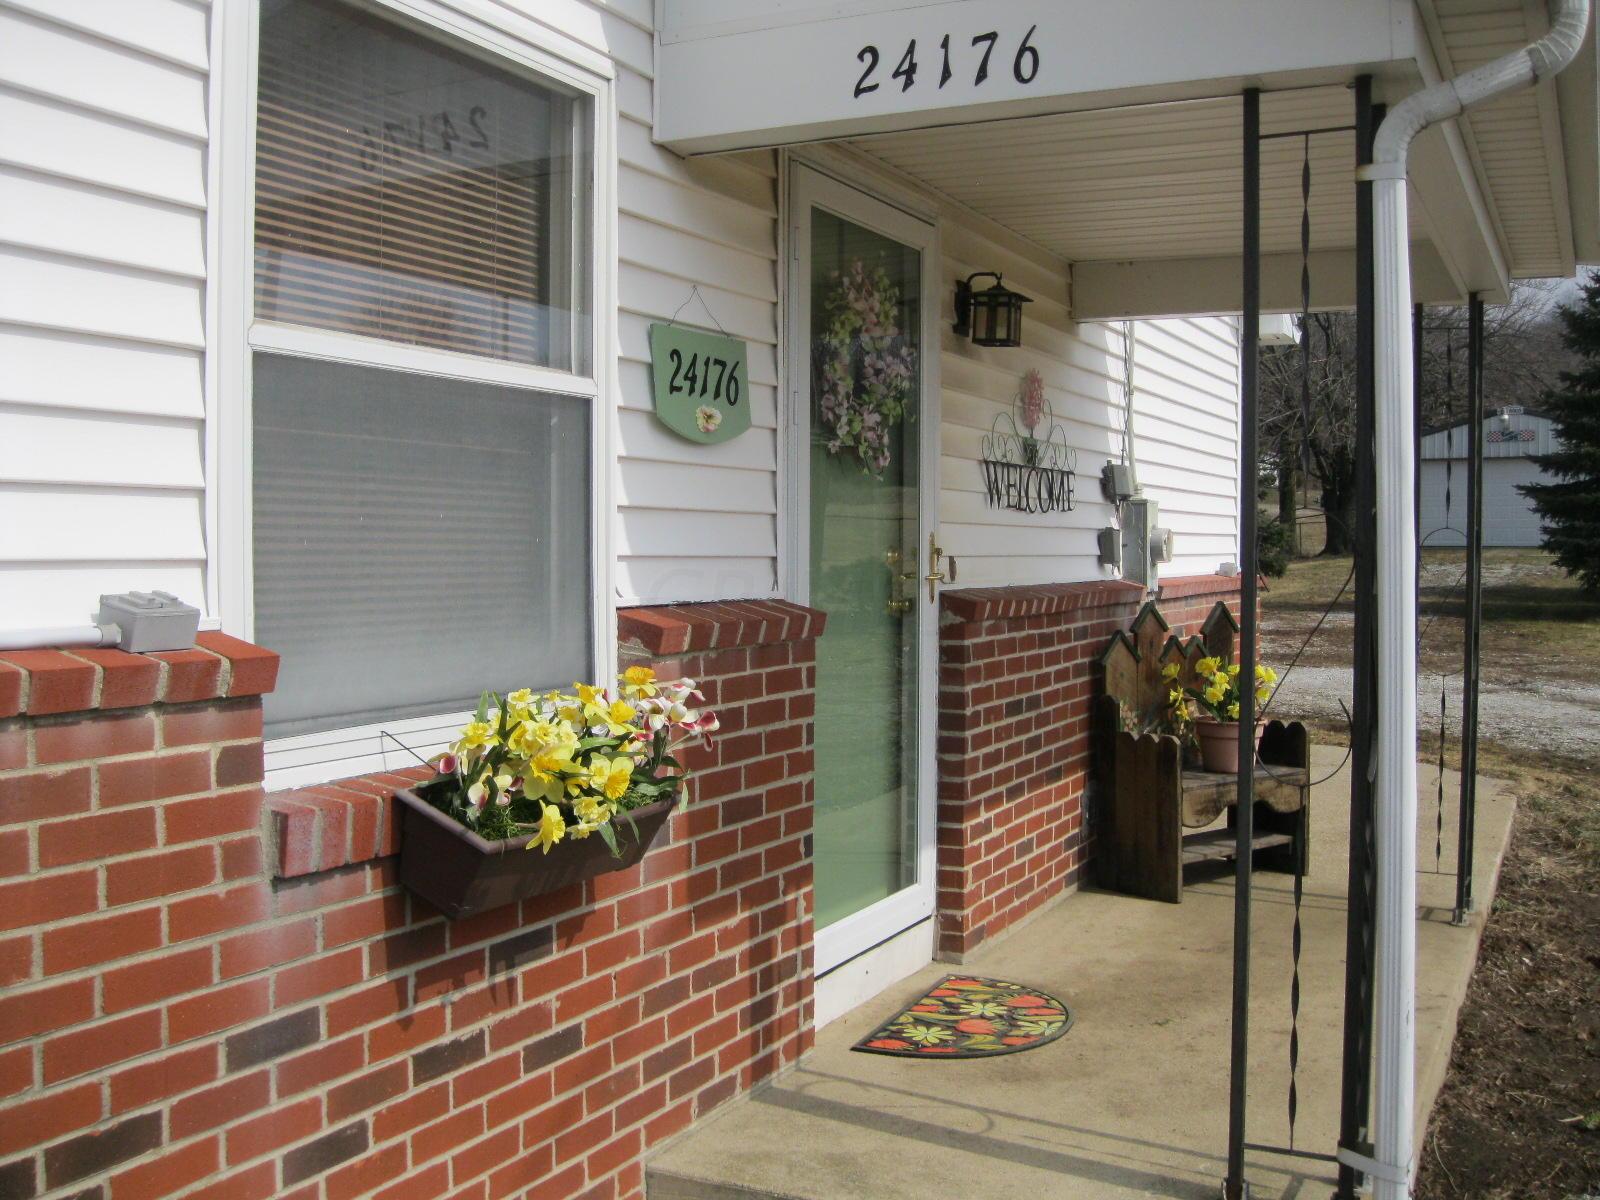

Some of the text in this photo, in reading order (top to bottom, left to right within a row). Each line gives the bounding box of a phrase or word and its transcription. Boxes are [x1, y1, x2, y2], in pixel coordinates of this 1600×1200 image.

[853, 24, 1040, 99] 24176
[669, 348, 740, 407] 24176
[984, 460, 1077, 514] WELCOME
